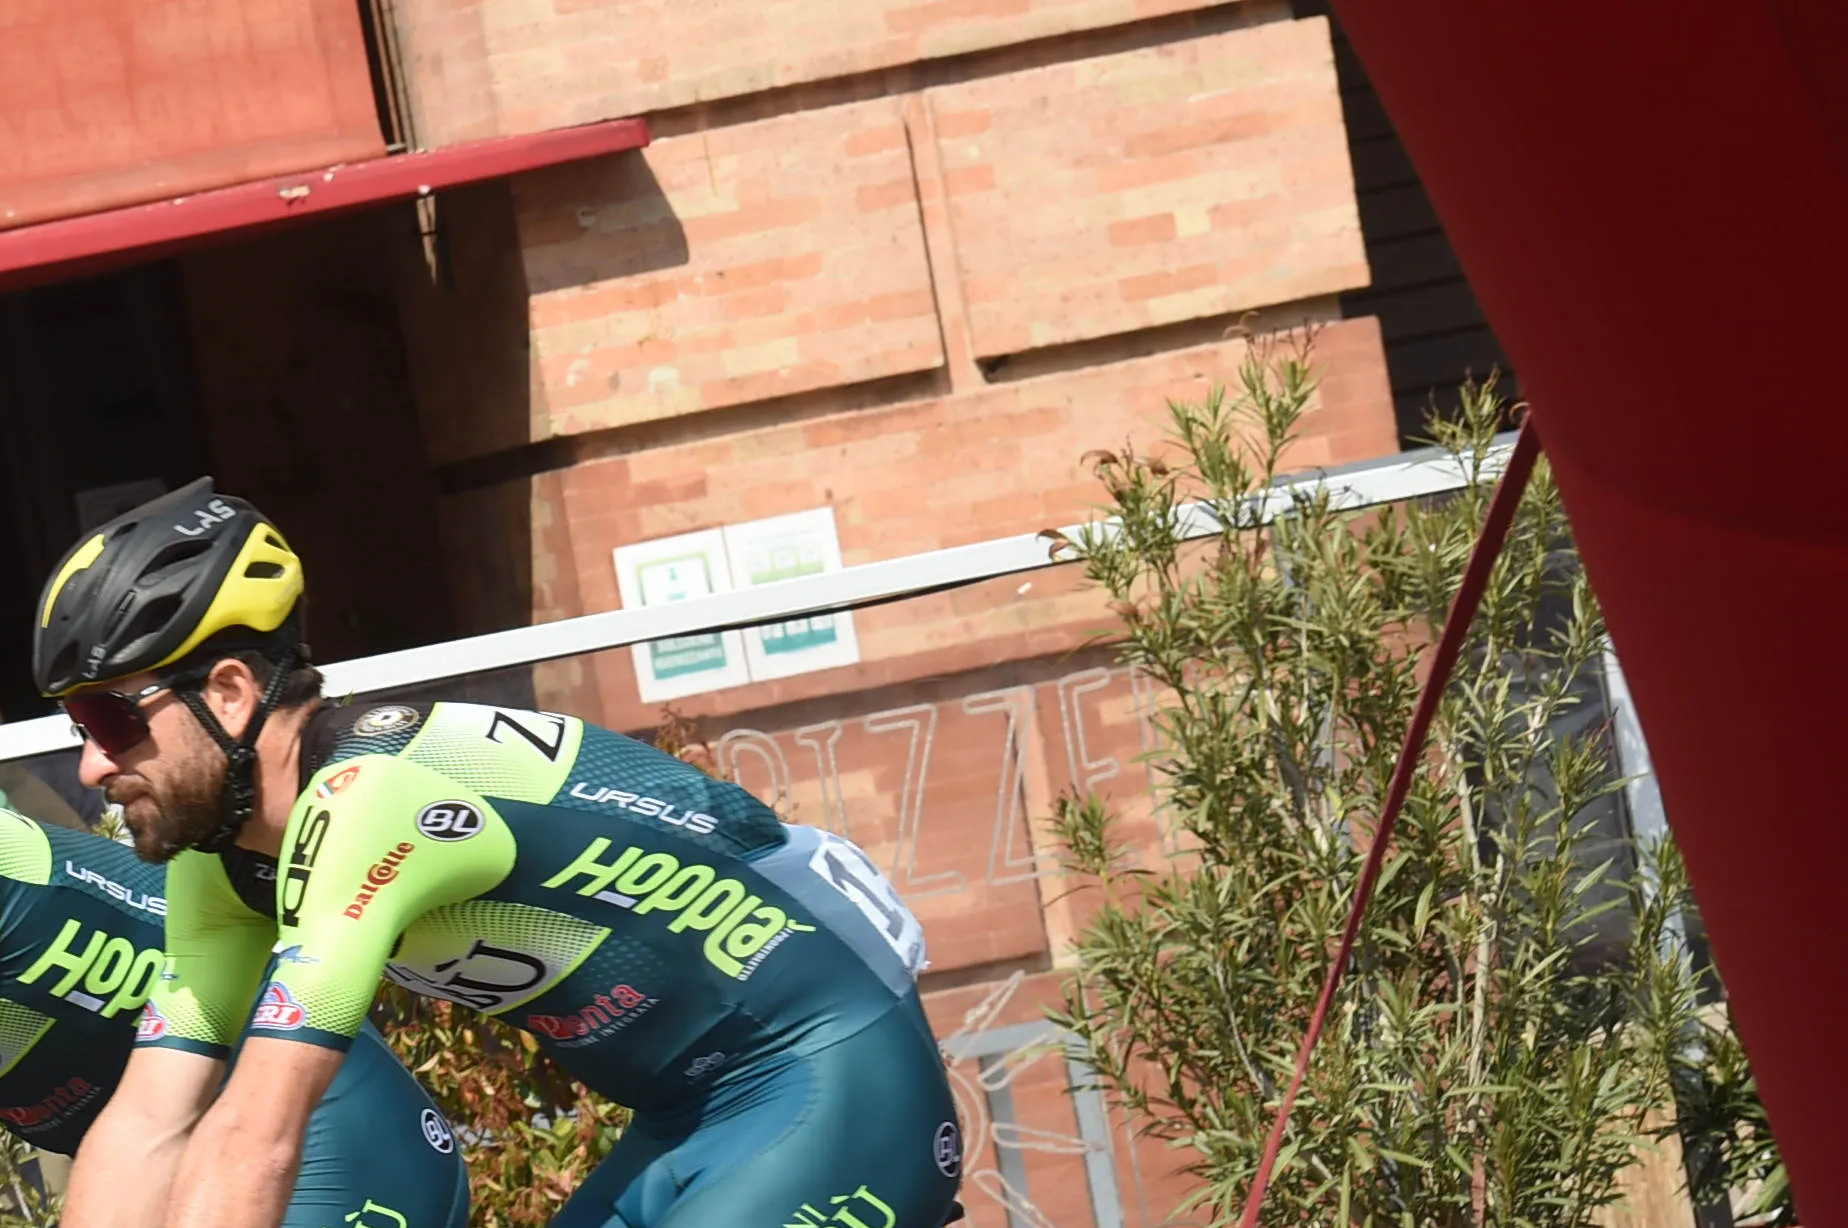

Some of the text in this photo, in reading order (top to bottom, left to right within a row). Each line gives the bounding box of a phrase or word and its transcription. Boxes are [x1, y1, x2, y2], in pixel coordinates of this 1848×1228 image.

[174, 499, 236, 537] LAS
[570, 782, 719, 835] URSUS
[64, 860, 168, 917] URSUS
[280, 805, 331, 927] SIDI
[17, 918, 166, 1019] Hop
